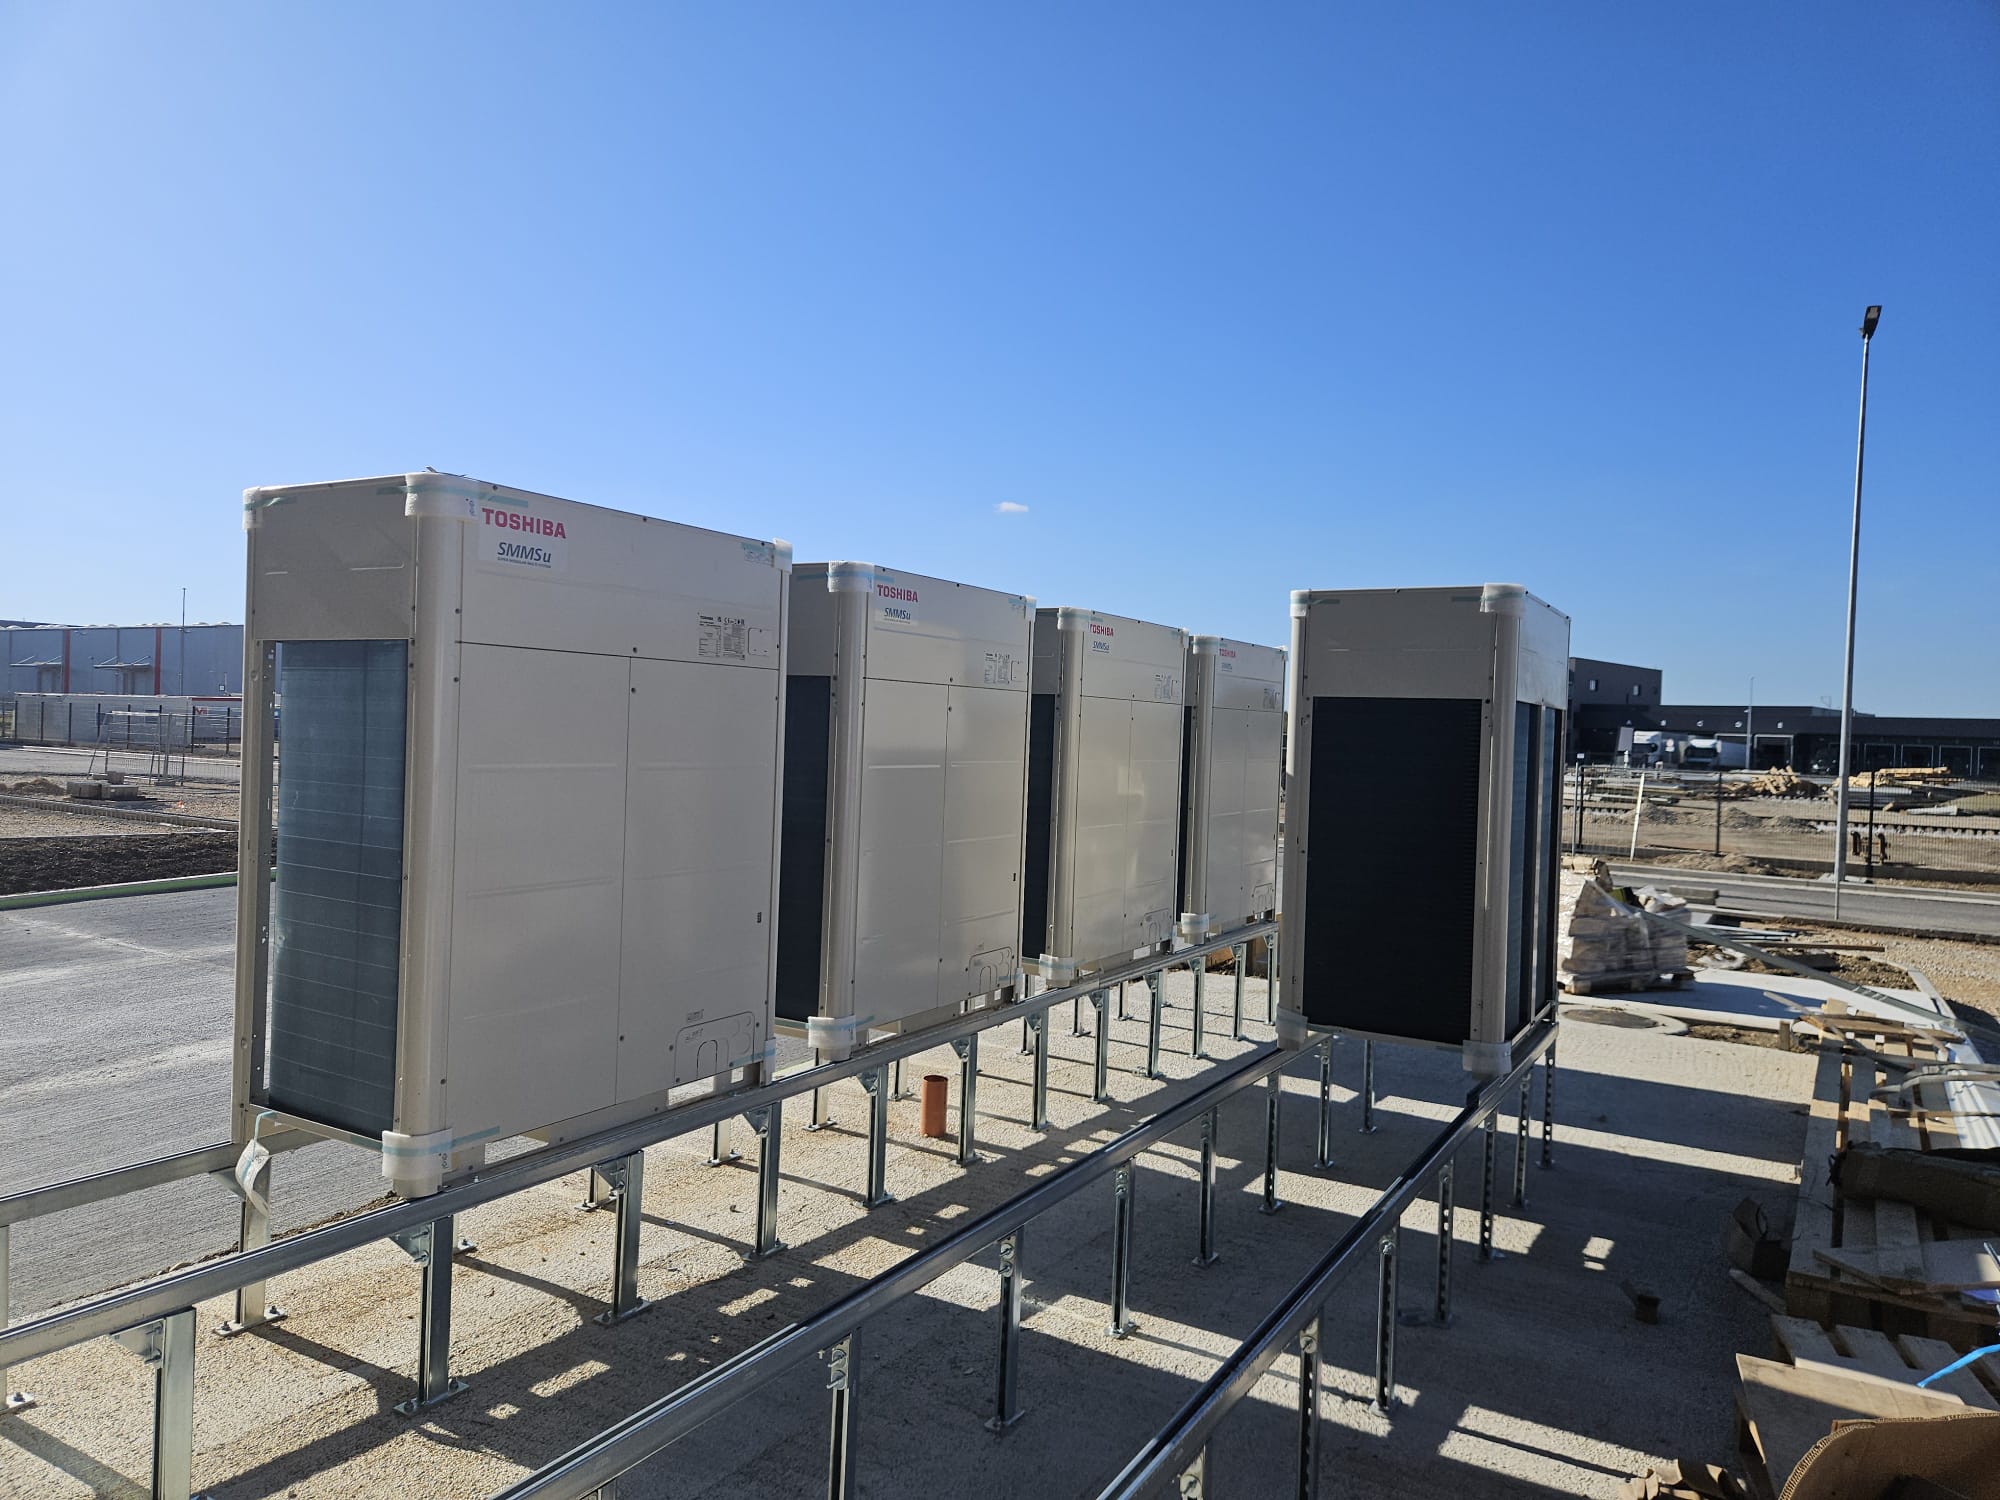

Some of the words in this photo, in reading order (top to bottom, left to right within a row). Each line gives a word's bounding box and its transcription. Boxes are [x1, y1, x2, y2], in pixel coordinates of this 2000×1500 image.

[482, 507, 566, 539] TOSHIBA
[497, 542, 552, 563] SMMSu
[877, 584, 918, 603] TOSHIBA
[884, 607, 911, 620] SMMSu
[1090, 623, 1114, 637] TOSHIBA
